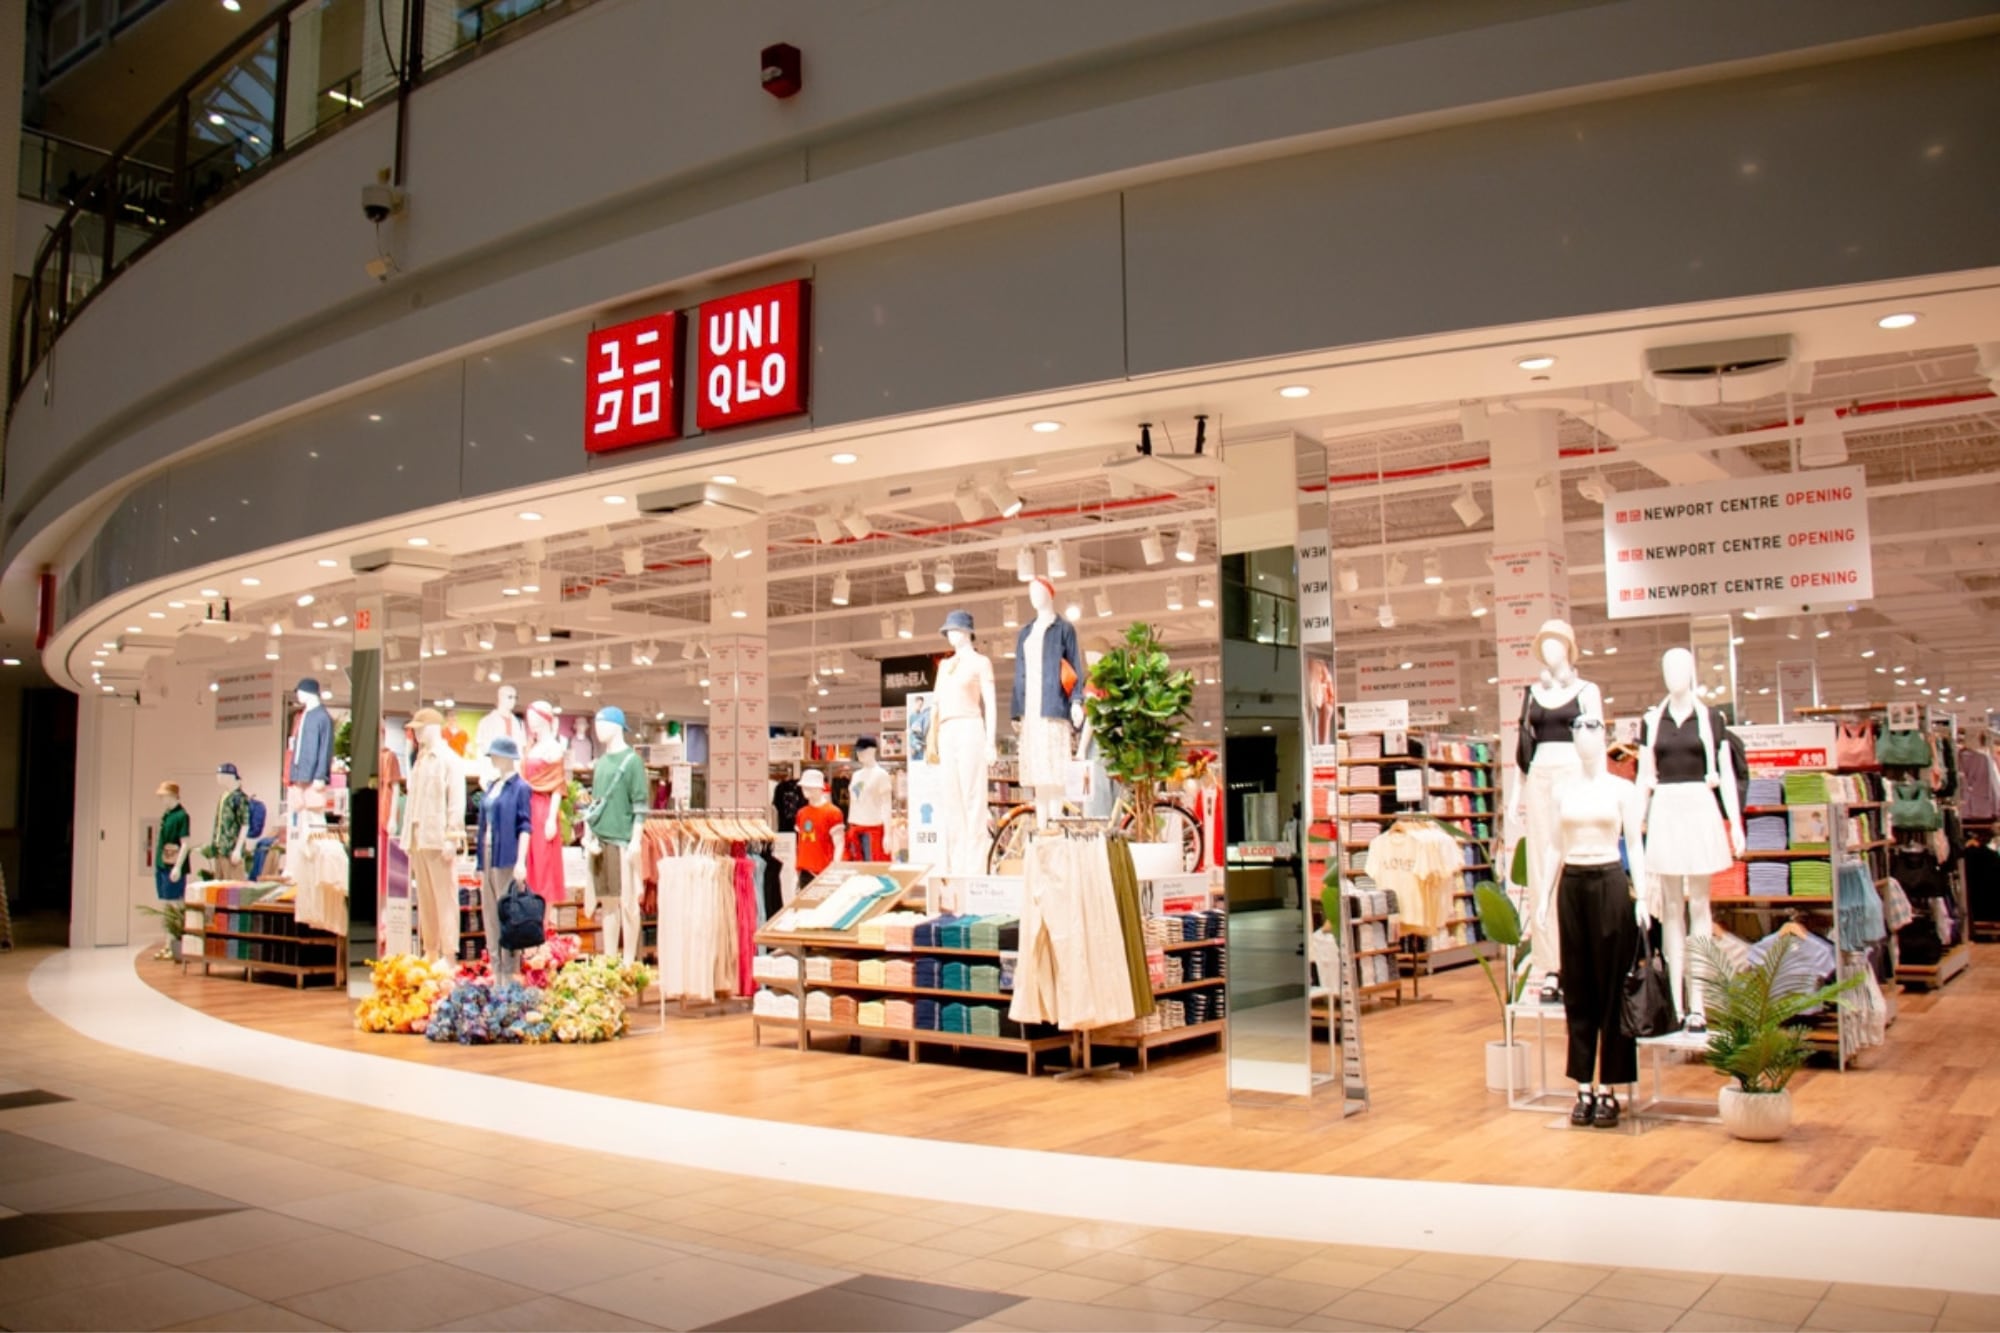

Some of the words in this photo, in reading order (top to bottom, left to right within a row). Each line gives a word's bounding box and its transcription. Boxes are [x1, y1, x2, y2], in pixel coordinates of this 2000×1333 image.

[709, 300, 780, 356] UNI
[707, 352, 786, 414] QLO
[1644, 501, 1714, 521] NEWPORT
[1720, 494, 1780, 513] CENTRE
[1785, 486, 1853, 506] OPENING
[1646, 541, 1716, 560] NEWPORT
[1722, 535, 1782, 553] CENTRE
[1788, 528, 1855, 547] OPENING
[1648, 581, 1718, 600] NEWPORT
[1725, 576, 1784, 593] CENTRE
[1790, 570, 1858, 588] OPENING
